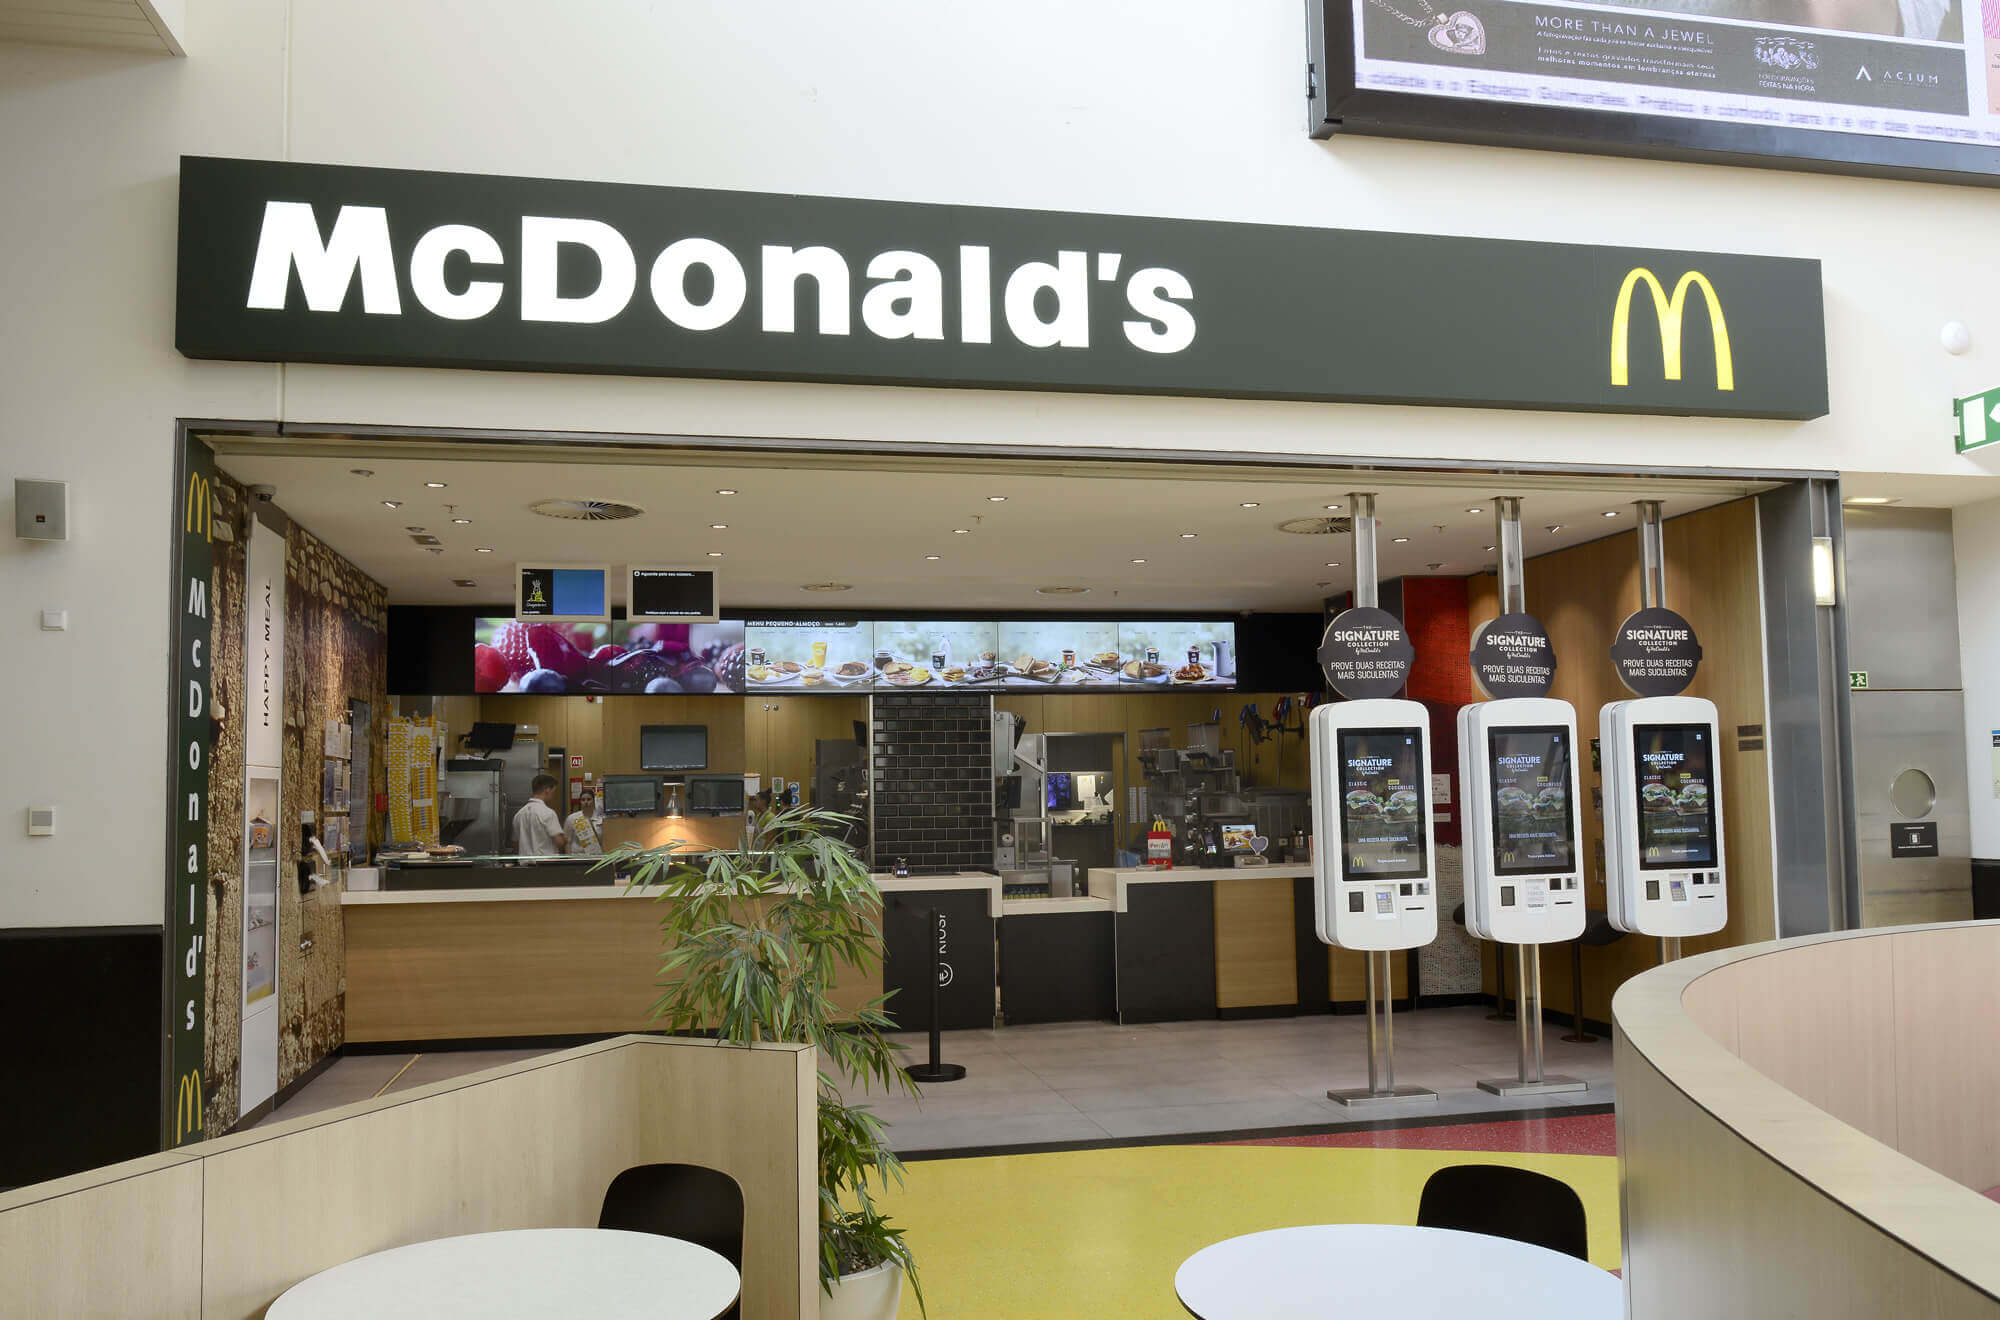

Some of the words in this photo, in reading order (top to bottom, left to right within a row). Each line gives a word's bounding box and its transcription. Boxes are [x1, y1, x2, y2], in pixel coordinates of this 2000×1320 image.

[1535, 15, 1584, 32] MORE
[1591, 20, 1638, 37] THAN
[1644, 27, 1655, 39] A
[1661, 29, 1715, 46] JEWEL
[1602, 52, 1640, 64] gravados
[1537, 55, 1576, 66] melhores
[1578, 59, 1621, 70] momentos
[1686, 69, 1717, 79] eternas
[246, 200, 1198, 354] McDonald's
[264, 577, 272, 642] MEAL
[1334, 630, 1400, 642] SIGNATURE
[1626, 629, 1688, 641] SIGNATURE
[1486, 635, 1546, 648] SIGNATURE
[1331, 661, 1354, 671] PROVE
[1355, 661, 1374, 670] DUAS
[1376, 660, 1405, 670] RECEITAS
[1623, 659, 1645, 668] PROVE
[1646, 659, 1664, 668] DUAS
[1665, 659, 1693, 668] RECEITAS
[1337, 671, 1355, 680] MAIS
[1482, 664, 1505, 674] PROVE
[1506, 665, 1524, 674] DUAS
[1525, 666, 1551, 676] RECEITAS
[1629, 668, 1646, 676] MAIS
[1489, 674, 1506, 683] MAIS
[1347, 758, 1393, 768] SIGNATURE
[1498, 756, 1541, 765] SIGNATURE
[1642, 753, 1685, 762] SIGNATURE
